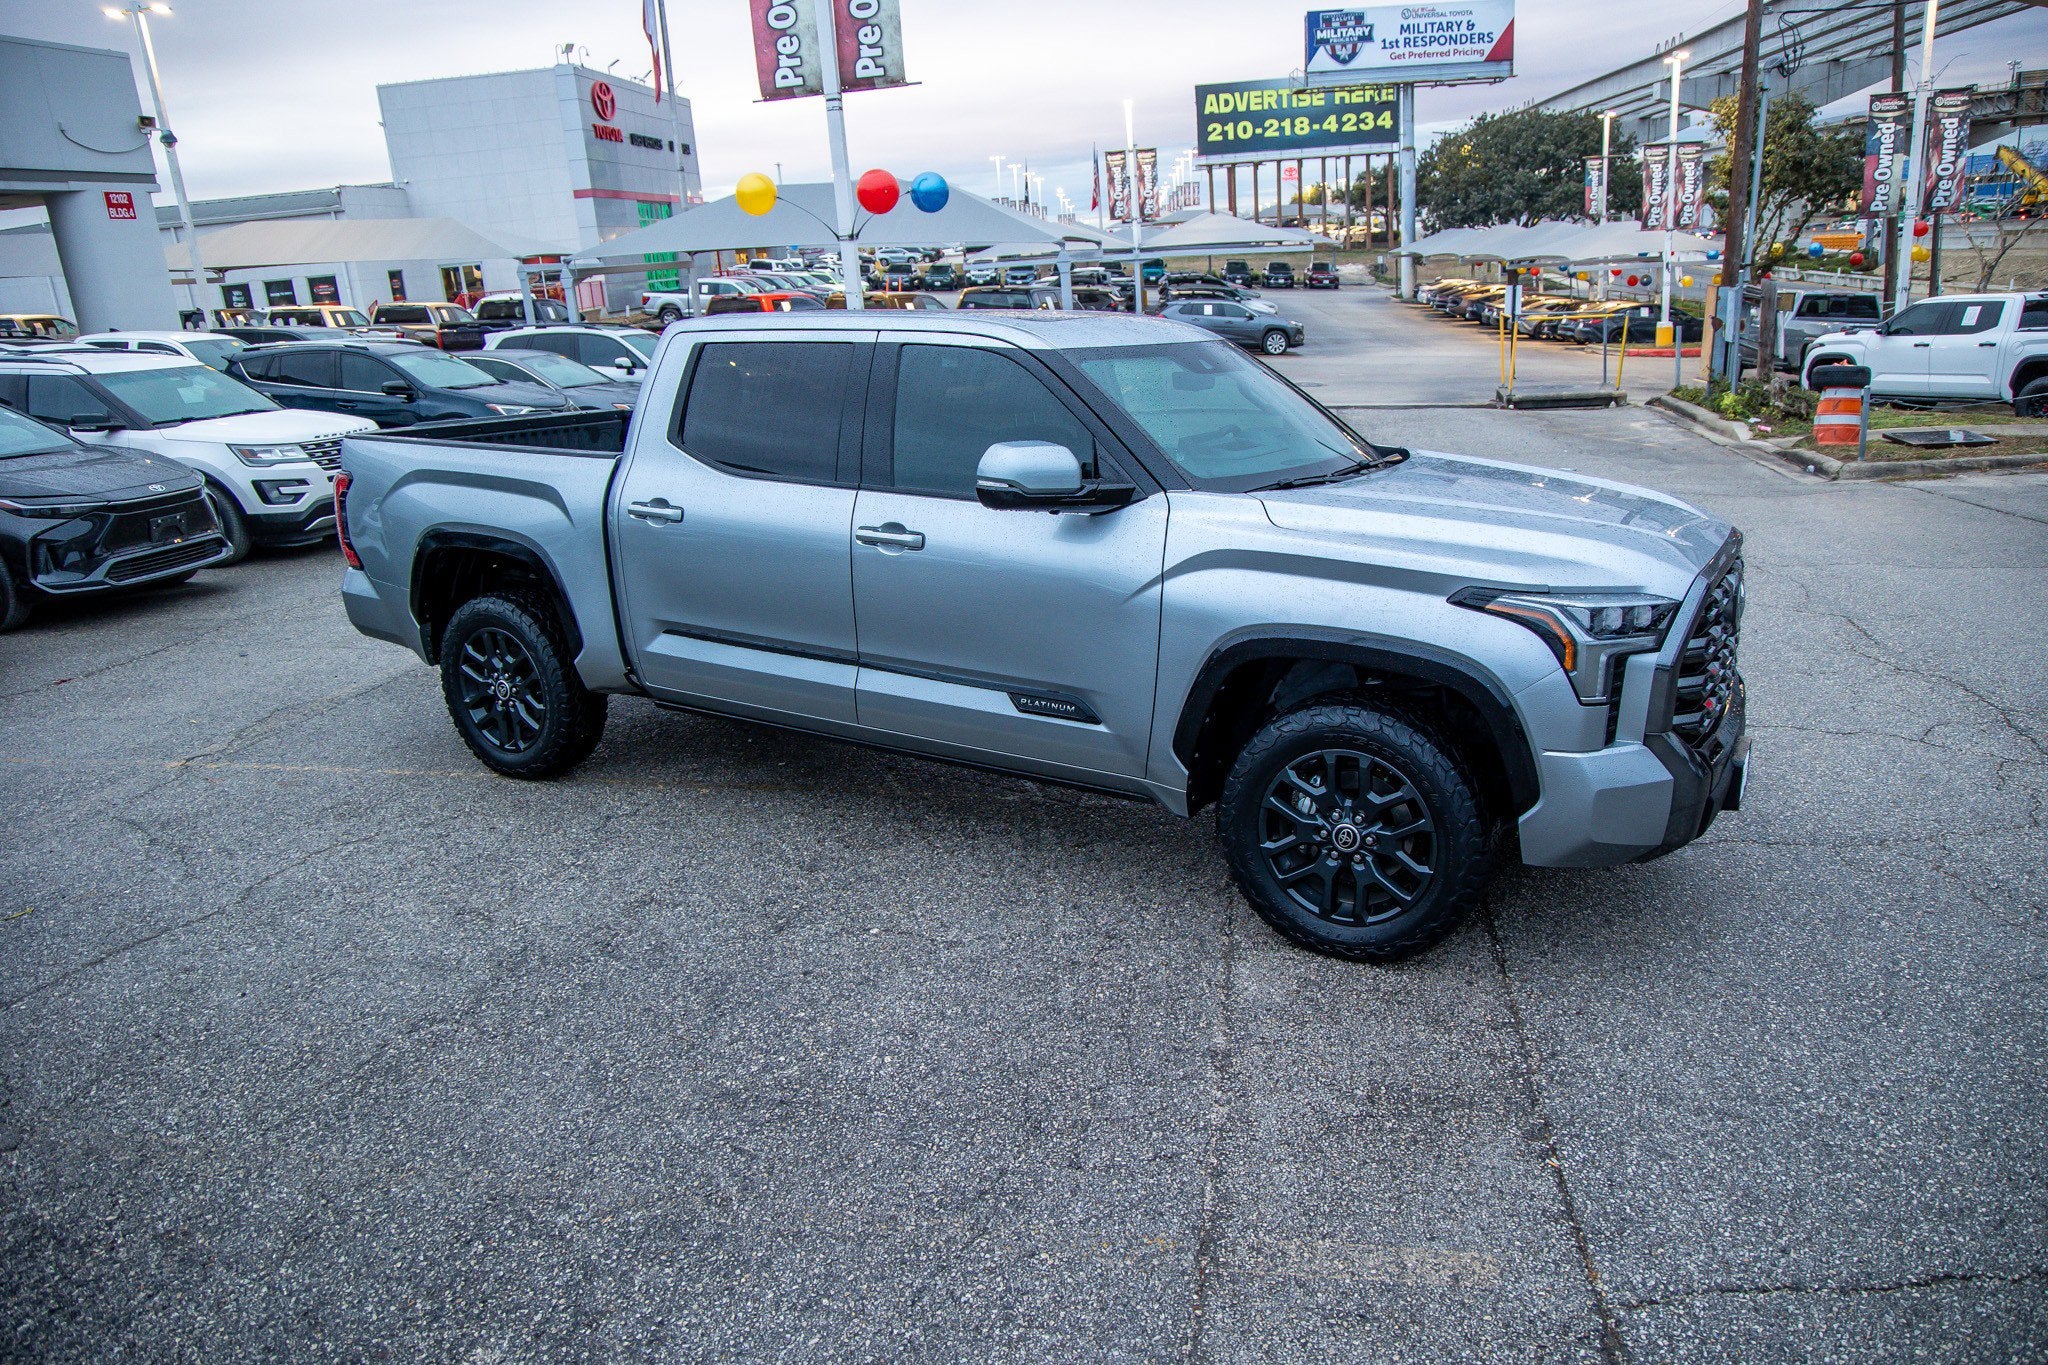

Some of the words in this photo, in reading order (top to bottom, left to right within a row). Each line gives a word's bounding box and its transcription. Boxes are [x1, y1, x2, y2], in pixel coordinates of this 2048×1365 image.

[1449, 9, 1473, 17] TOYOTA
[1316, 26, 1371, 39] MILITARY
[1381, 38, 1400, 49] 1st
[1403, 31, 1494, 48] RESPONDERS
[1400, 20, 1463, 35] MILITARY
[1466, 20, 1476, 31] &
[775, 35, 804, 88] Pre
[855, 24, 886, 79] Pre
[1389, 51, 1406, 60] Get
[1408, 48, 1451, 59] Preferred
[1453, 47, 1485, 58] Pricing
[1204, 87, 1325, 115] ADVERTISE
[592, 123, 624, 143] TOYOTA
[1207, 110, 1393, 142] 210-218-4234
[1874, 122, 1895, 180] Owned
[1936, 118, 1959, 176] Owned
[1649, 163, 1662, 204] Owned
[1682, 161, 1695, 203] Owned
[1932, 179, 1953, 207] Pre
[109, 193, 129, 204] 12102
[1870, 183, 1890, 212] Pre
[1020, 698, 1075, 713] PLATINUM
